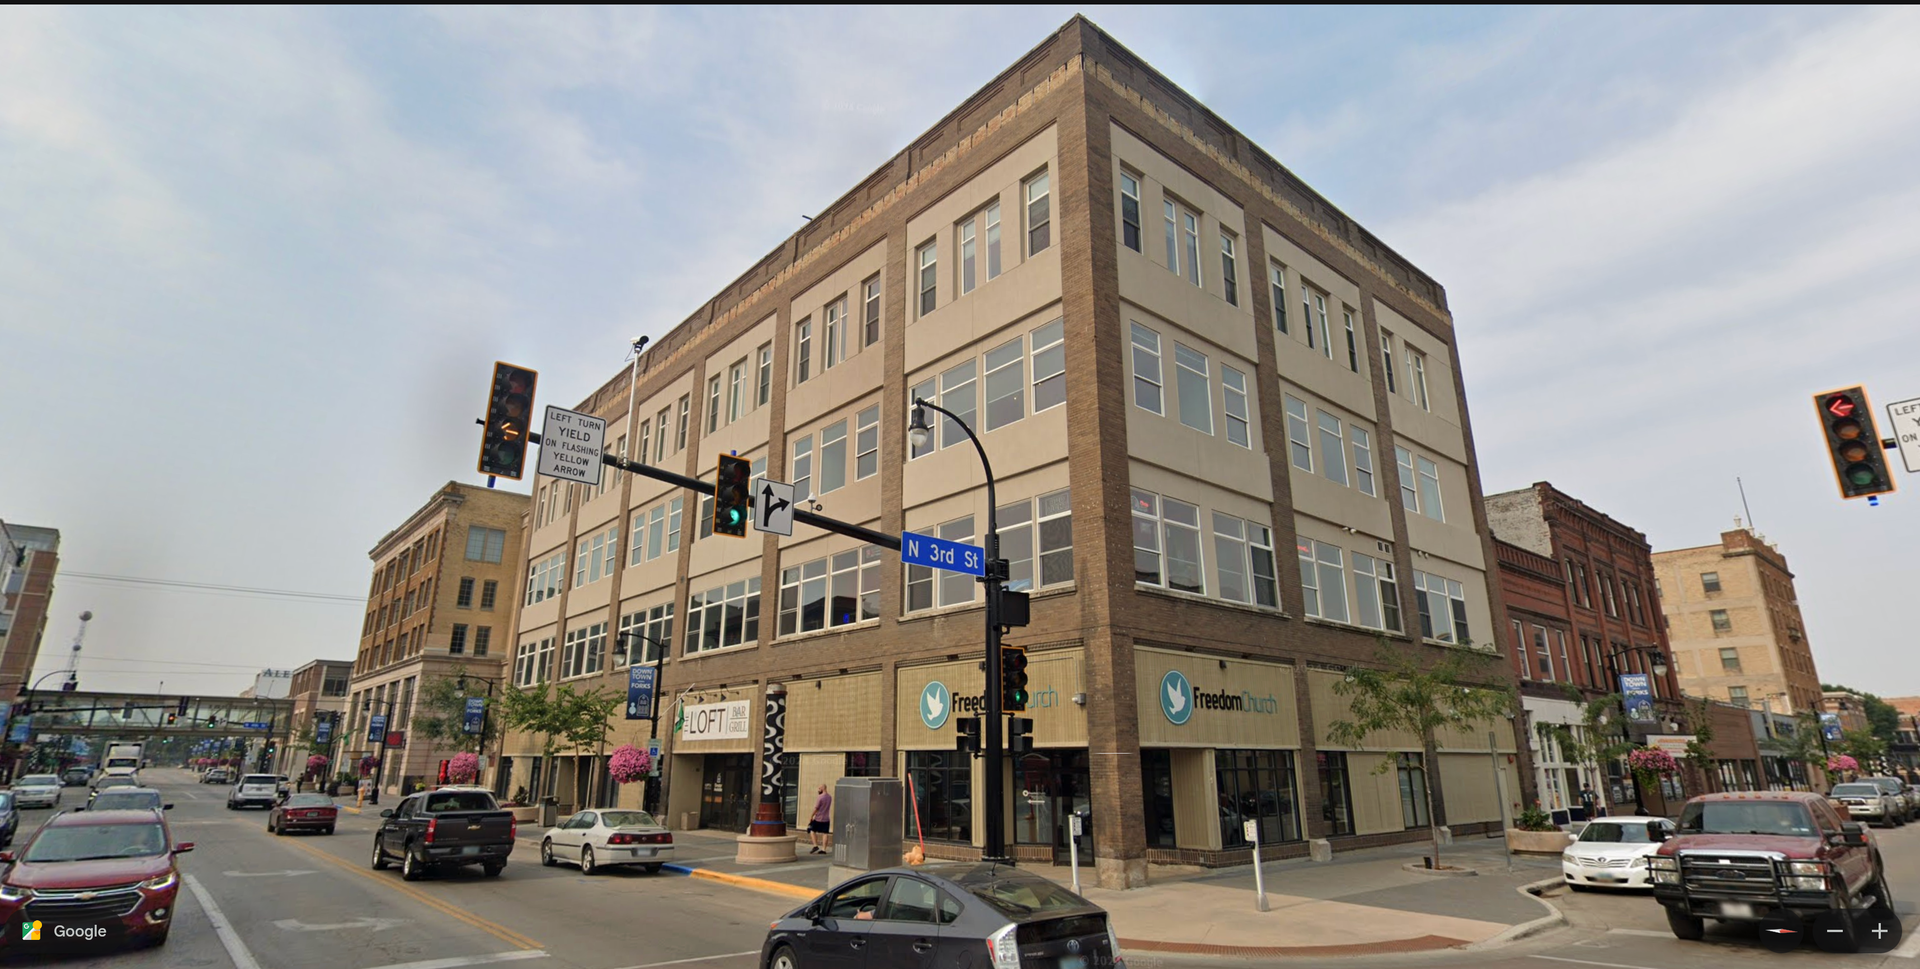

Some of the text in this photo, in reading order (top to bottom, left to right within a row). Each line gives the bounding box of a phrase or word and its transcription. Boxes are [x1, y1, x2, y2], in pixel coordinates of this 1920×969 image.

[550, 412, 601, 430] LEFT TURN
[559, 426, 591, 442] YIELD
[1902, 433, 1918, 443] ON
[545, 438, 599, 457] ON FLASHING
[553, 452, 589, 466] YELLOW
[553, 464, 586, 477] ARROW
[909, 539, 978, 569] N 3rd St
[732, 706, 746, 717] BAR
[690, 708, 726, 734] LOFT
[729, 721, 747, 732] GRILL
